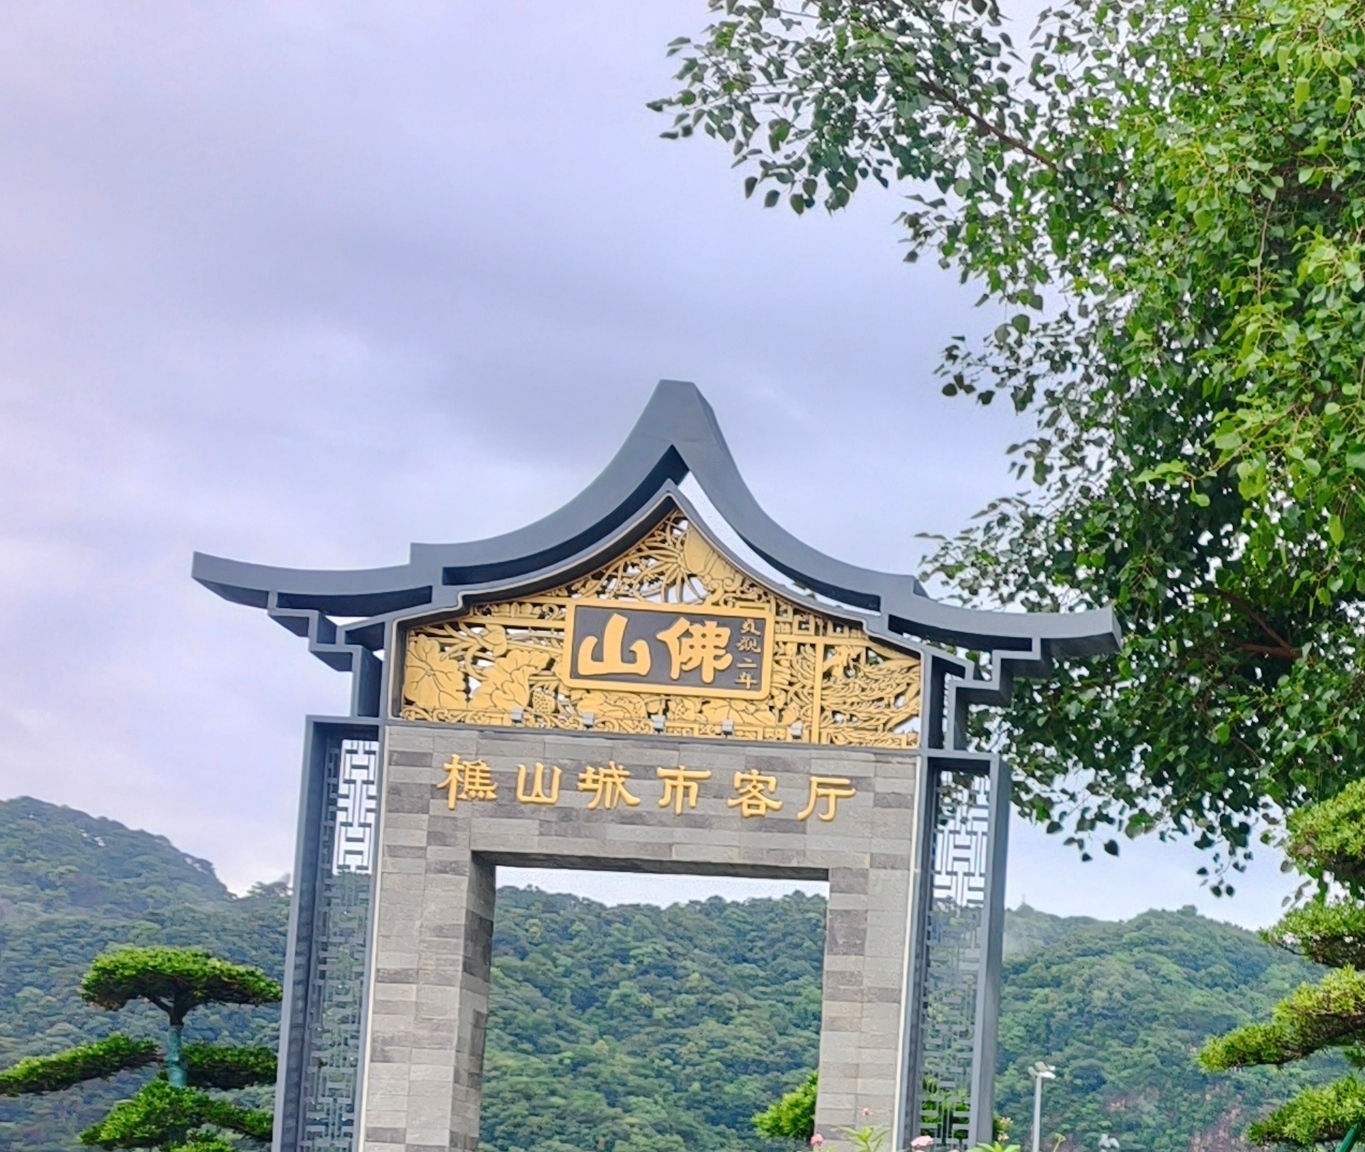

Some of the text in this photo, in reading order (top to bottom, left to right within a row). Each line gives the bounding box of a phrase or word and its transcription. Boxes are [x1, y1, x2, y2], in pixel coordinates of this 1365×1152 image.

[436, 753, 858, 823] 樵山城市客厅
